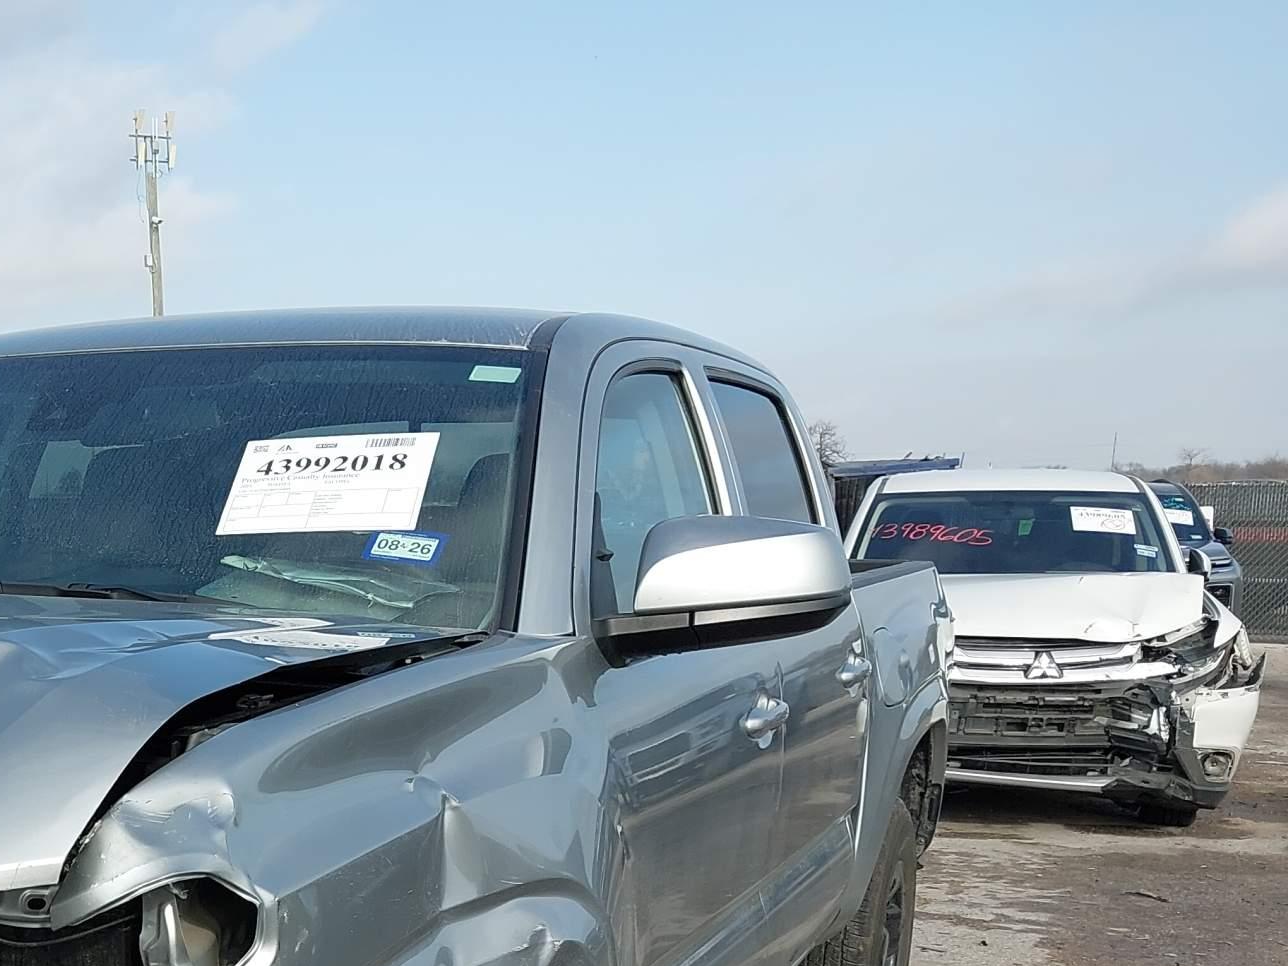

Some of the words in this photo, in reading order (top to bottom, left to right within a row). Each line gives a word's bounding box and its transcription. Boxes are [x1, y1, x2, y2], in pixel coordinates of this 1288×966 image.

[256, 452, 409, 476] 43992018
[377, 538, 401, 551] 08
[408, 542, 433, 555] 26
